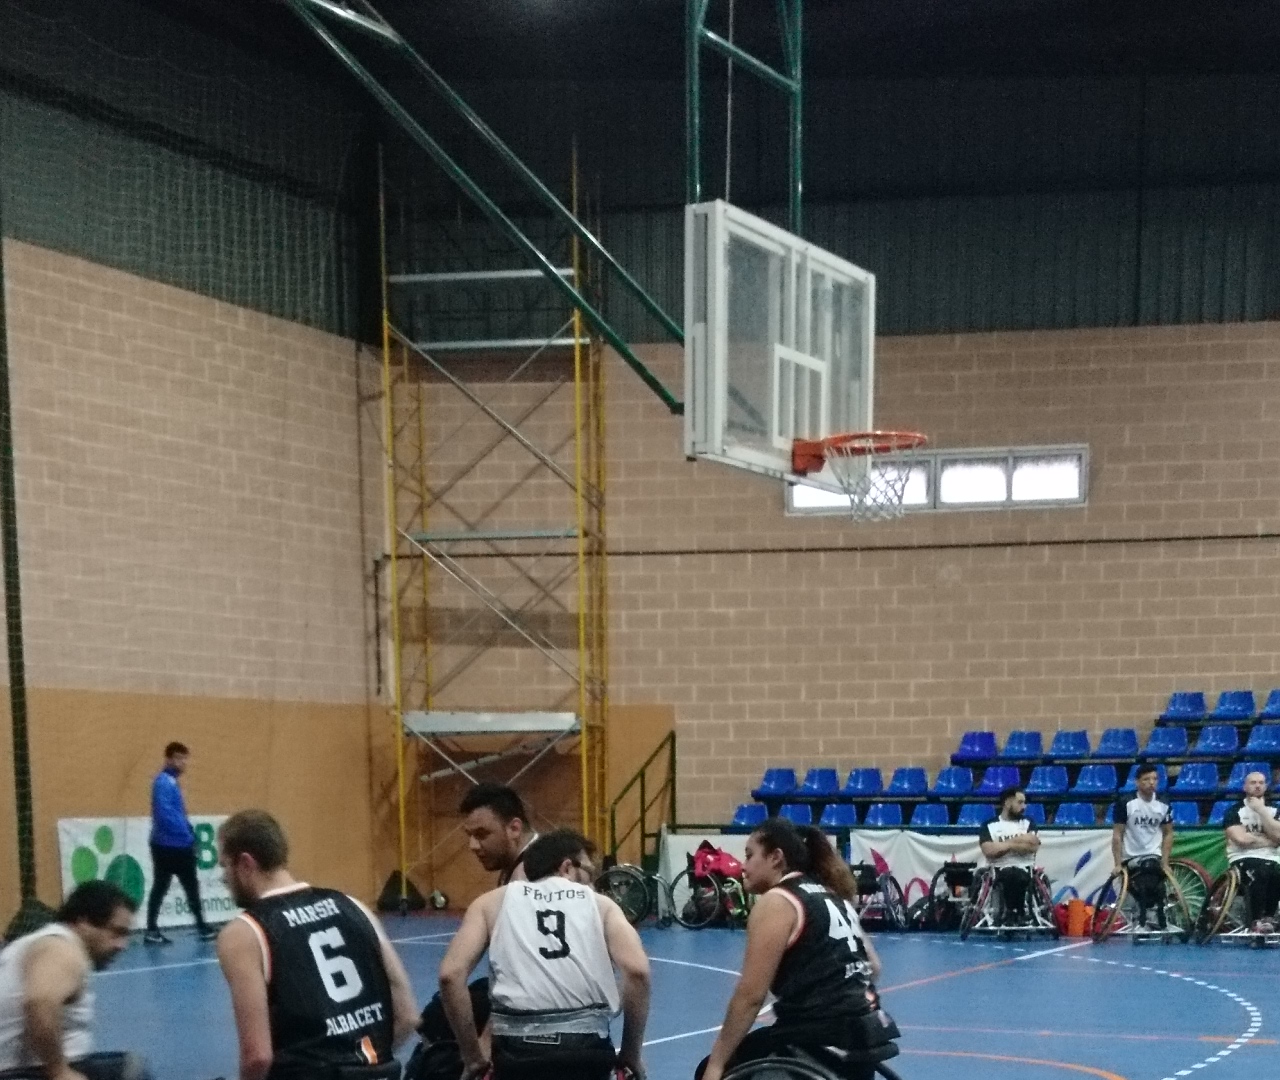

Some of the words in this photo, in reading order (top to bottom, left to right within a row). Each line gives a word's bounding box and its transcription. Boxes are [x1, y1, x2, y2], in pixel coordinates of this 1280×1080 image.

[282, 898, 340, 928] MARSH
[536, 909, 570, 960] 9
[308, 926, 363, 1003] 6
[325, 1002, 383, 1037] ALBACET
